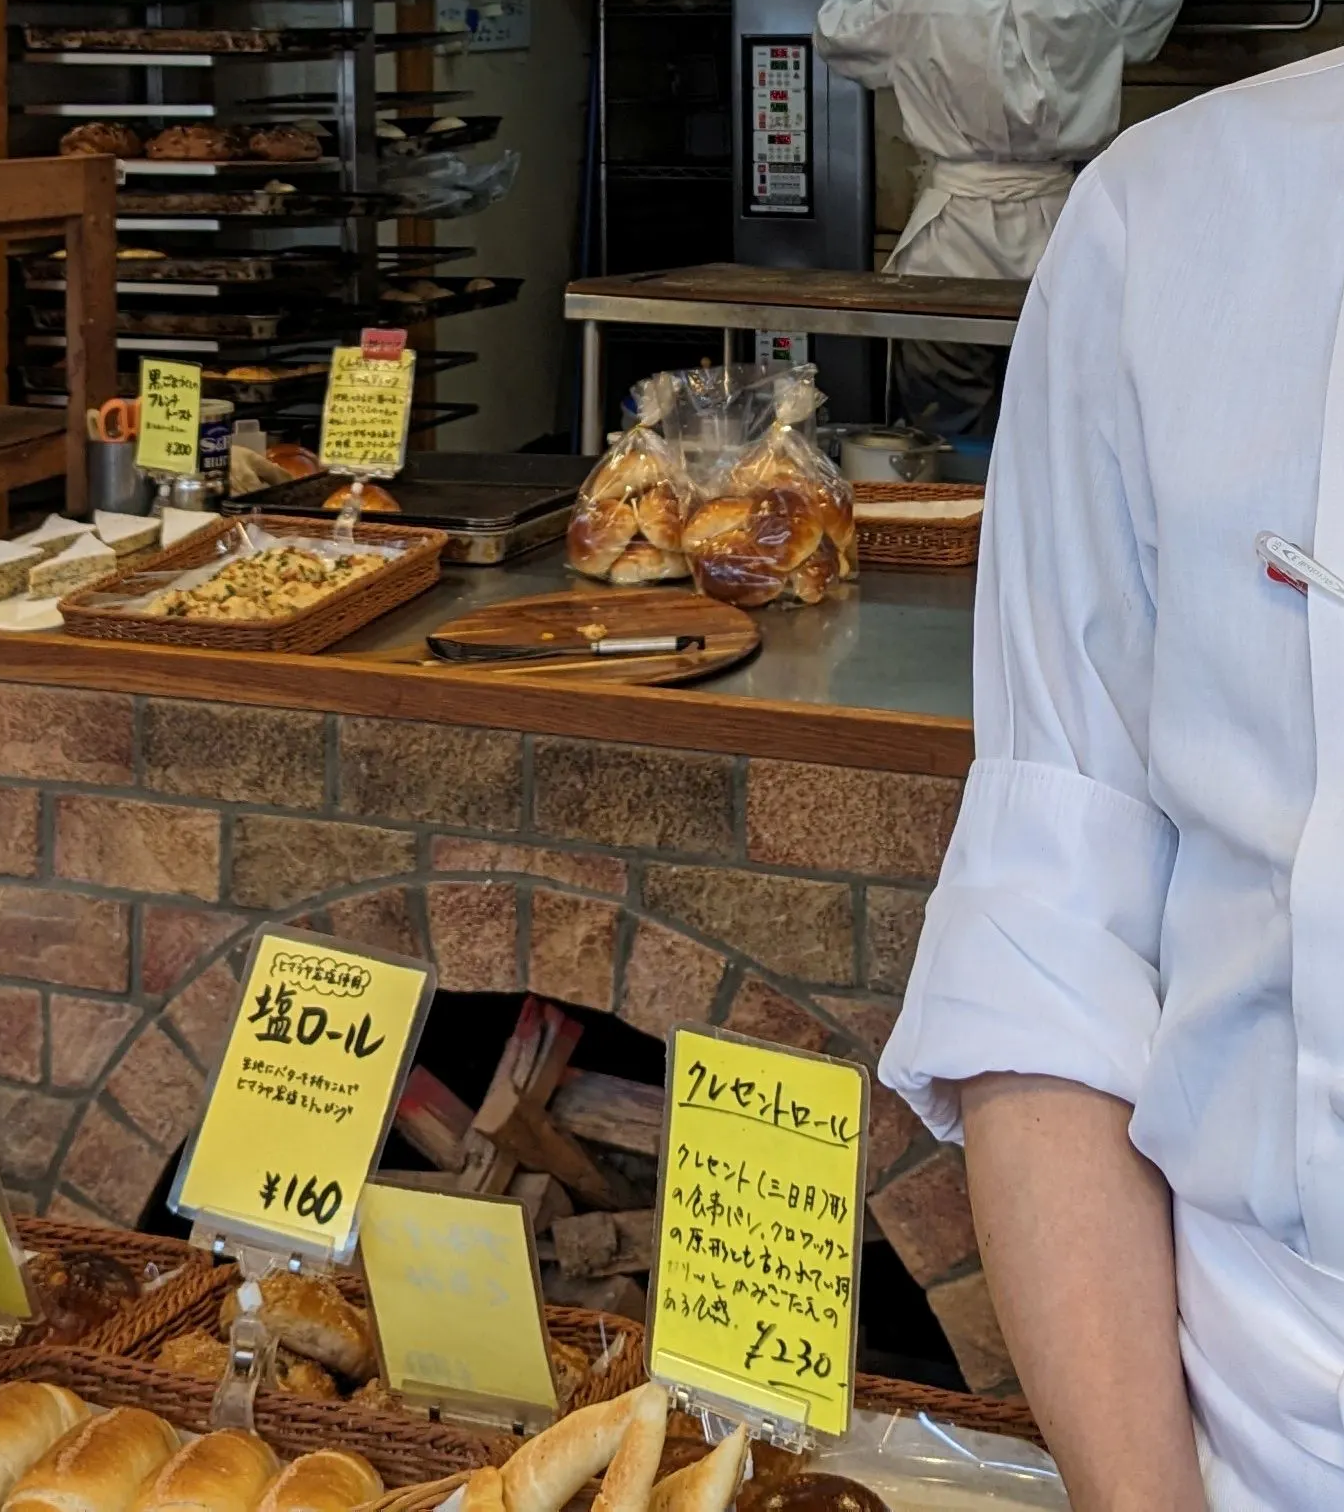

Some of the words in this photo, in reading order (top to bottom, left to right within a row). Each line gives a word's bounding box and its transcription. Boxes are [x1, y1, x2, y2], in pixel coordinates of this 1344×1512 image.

[147, 393, 181, 408] フレンチ
[165, 407, 193, 422] トースト
[165, 441, 193, 457] ¥200
[278, 959, 364, 991] ヒマラヤ岩塩使用
[247, 981, 387, 1059] 塩ロール
[686, 1059, 860, 1143] クレセントロール
[259, 1170, 343, 1225] ¥160
